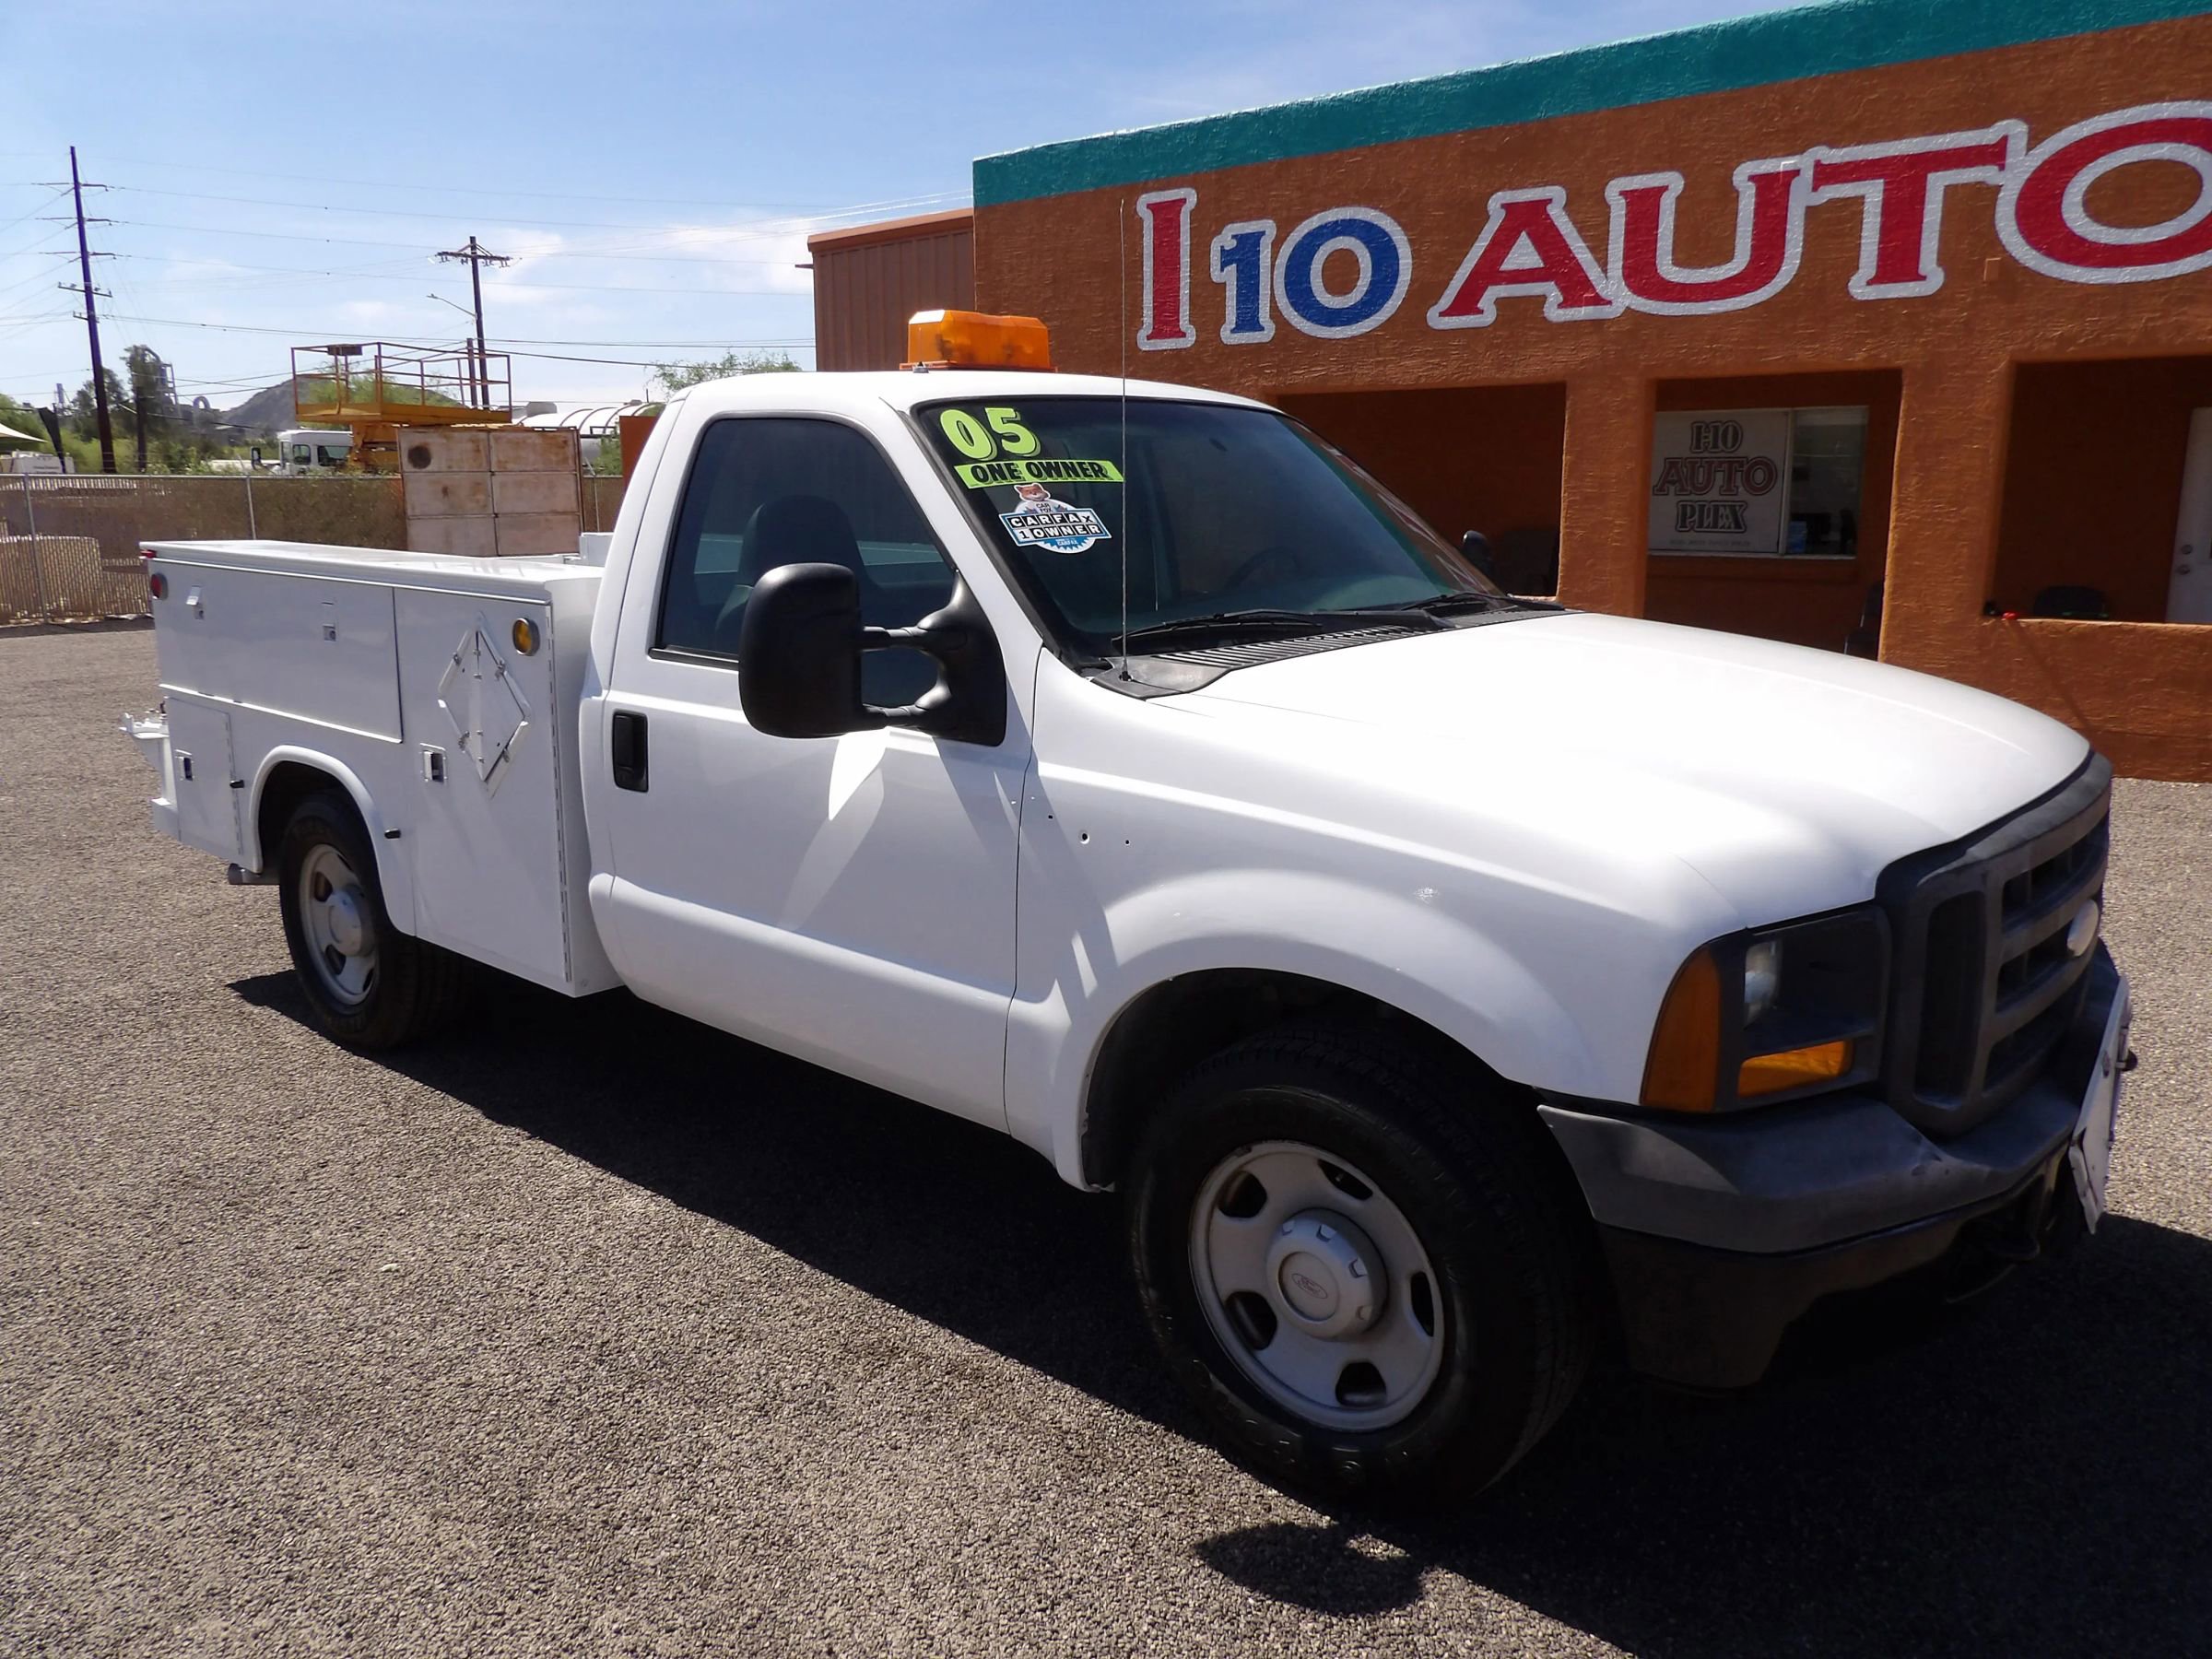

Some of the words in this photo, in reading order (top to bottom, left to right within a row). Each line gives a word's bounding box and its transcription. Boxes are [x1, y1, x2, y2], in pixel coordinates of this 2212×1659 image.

[1426, 100, 2212, 331] AUTO
[940, 407, 1041, 461] 05
[971, 463, 1024, 485] ONE
[1024, 461, 1111, 480] OWNER
[1652, 456, 1778, 496] AUTO
[1009, 512, 1094, 527] CARFAX
[1018, 530, 1030, 540] 1
[1032, 524, 1101, 538] OWNER
[1675, 500, 1748, 535] PLEX
